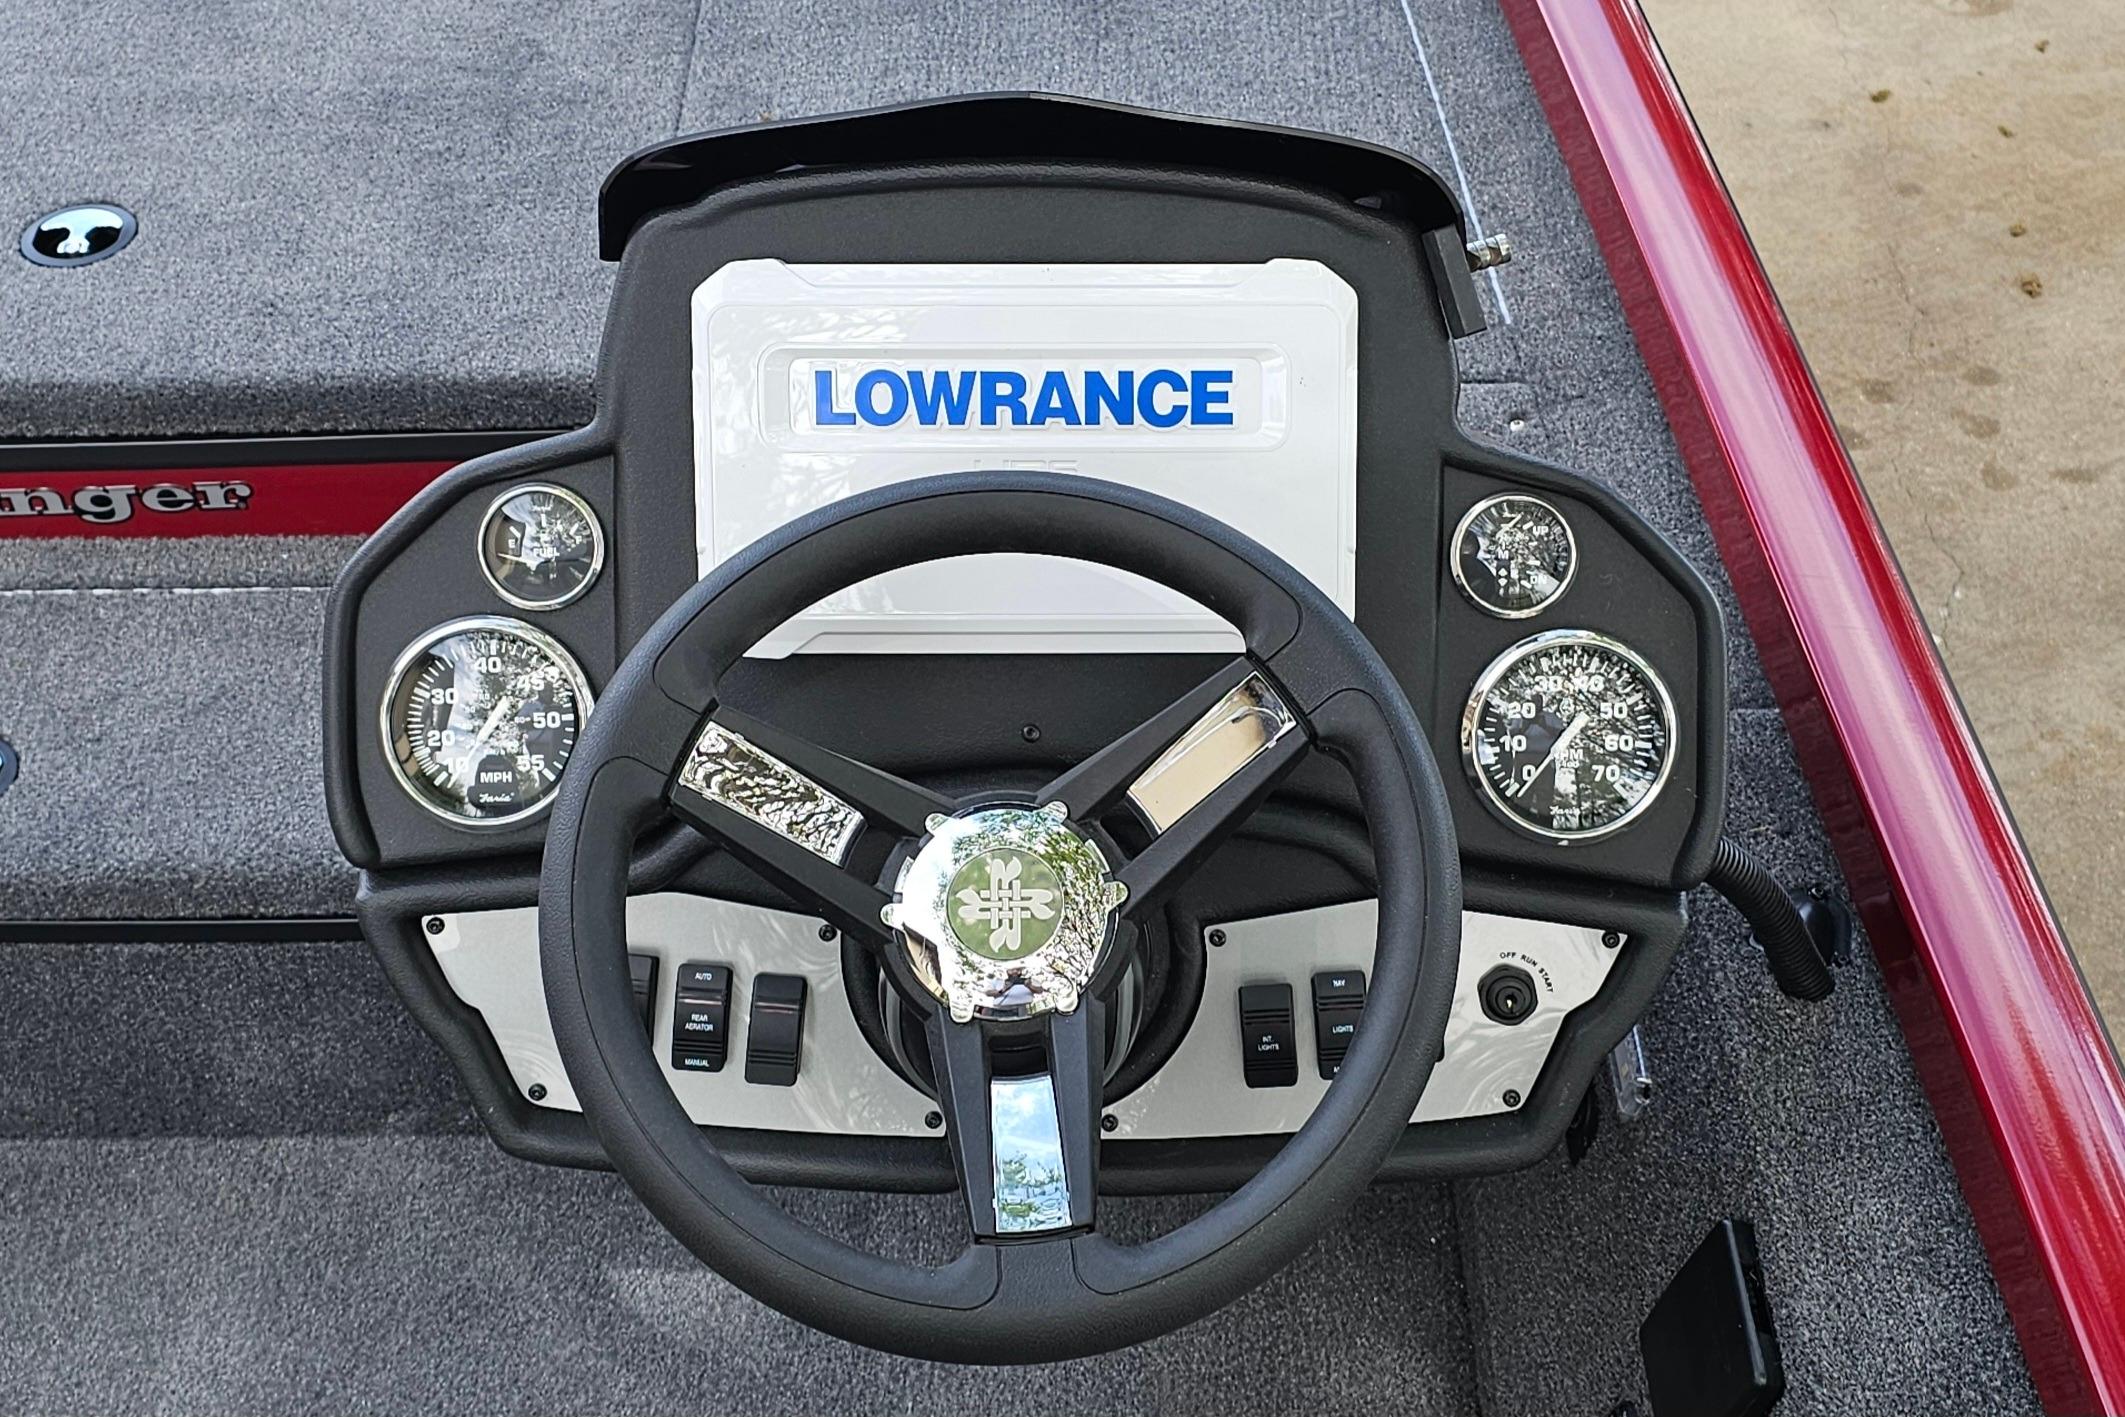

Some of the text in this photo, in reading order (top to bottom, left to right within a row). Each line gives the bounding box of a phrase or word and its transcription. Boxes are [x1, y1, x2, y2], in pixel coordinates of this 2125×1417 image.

[814, 369, 1234, 428] LOWRANCE
[1532, 525, 1549, 536] UP
[508, 539, 516, 549] E
[533, 548, 560, 558] FUEL
[475, 657, 502, 673] 40
[518, 673, 545, 690] 45
[431, 689, 458, 704] 30
[1509, 702, 1536, 719] 20
[1600, 702, 1628, 718] 50
[532, 711, 561, 729] 50
[427, 730, 455, 746] 20
[1500, 735, 1527, 752] 10
[1604, 735, 1634, 751] 60
[517, 755, 545, 771] 55
[1552, 749, 1584, 761] PM
[480, 770, 513, 783] MPH
[1522, 764, 1536, 781] 0
[1592, 764, 1621, 782] 70
[695, 973, 712, 981] AUTO
[1500, 951, 1554, 993] OFF RUN START
[691, 1014, 707, 1022] REAR
[685, 1023, 713, 1031] AERATOR
[1333, 1025, 1353, 1033] LIGHTS
[685, 1058, 709, 1066] MANUAL
